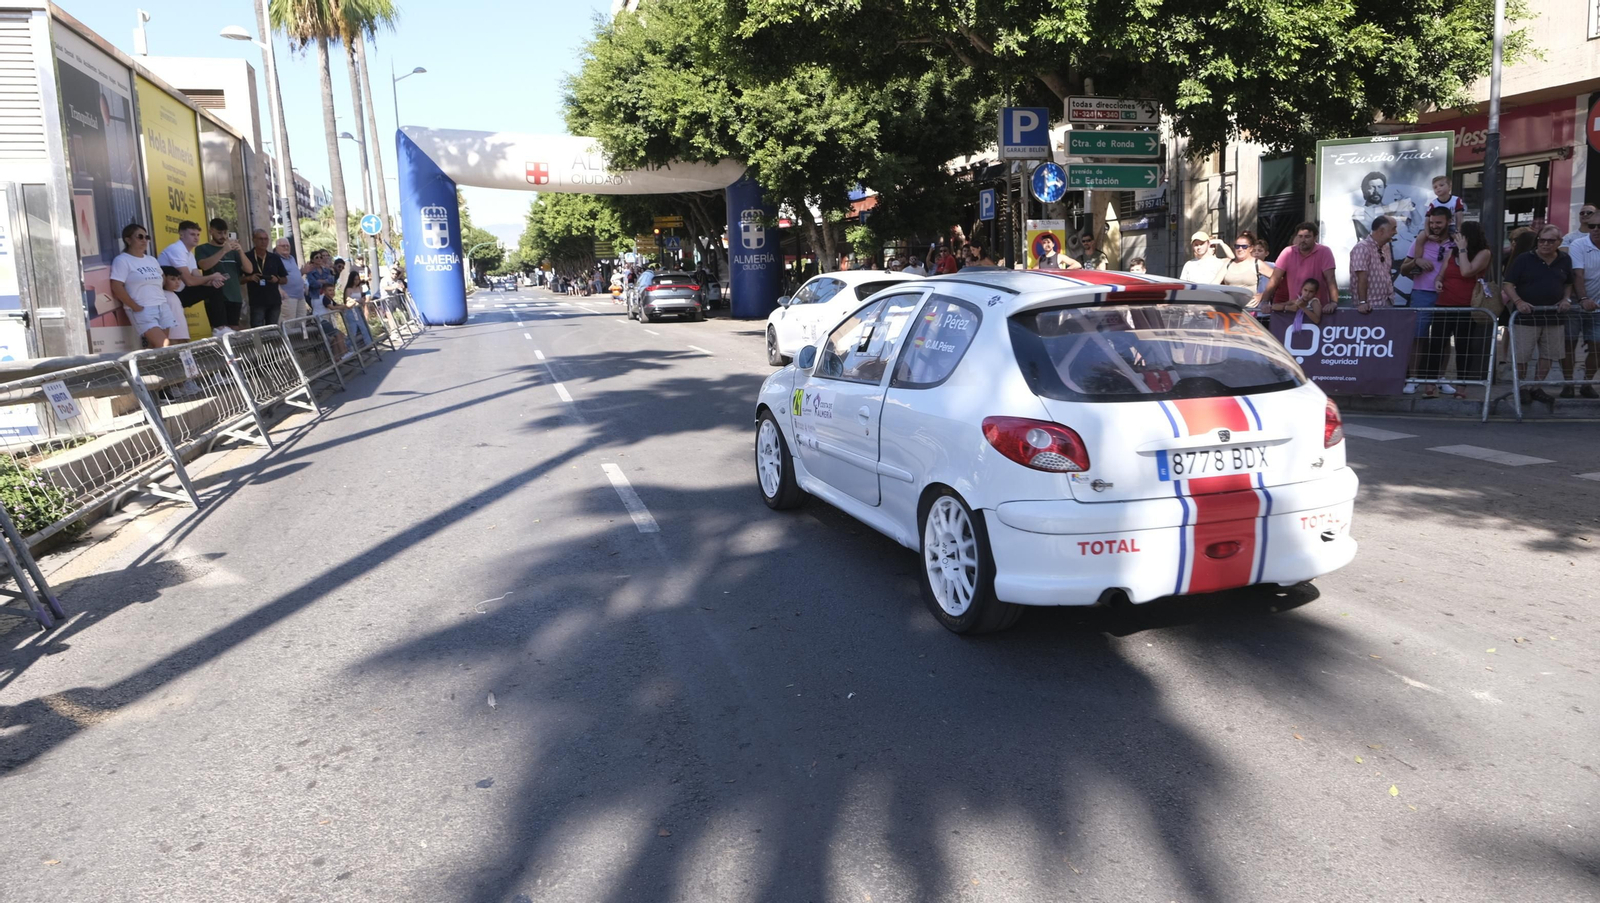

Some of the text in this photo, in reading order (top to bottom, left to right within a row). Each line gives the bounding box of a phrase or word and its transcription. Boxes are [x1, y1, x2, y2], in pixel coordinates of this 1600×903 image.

[1096, 101, 1135, 110] direcciones
[1012, 110, 1040, 144] P
[147, 127, 194, 168] Hola Almería
[1072, 139, 1135, 148] Ctra. de Ronda
[1334, 148, 1435, 166] Emidio Tucci
[570, 174, 623, 186] CIUDAD
[1070, 176, 1119, 185] La Estación
[168, 186, 189, 215] 50%
[982, 192, 991, 217] P
[414, 252, 460, 265] ALMERÍA
[733, 252, 775, 264] ALMERÍA
[425, 264, 453, 272] CIUDAD
[935, 313, 970, 330] J. Pérez
[1322, 326, 1385, 343] grupo
[1321, 340, 1394, 358] control
[1320, 357, 1358, 366] seguridad
[1311, 374, 1357, 382] grupocontrol.com
[51, 392, 68, 402] RENTA
[817, 409, 832, 419] ALMERÍA
[1172, 450, 1225, 475] 8778
[1231, 445, 1268, 470] BDX
[1077, 538, 1140, 556] TOTAL
